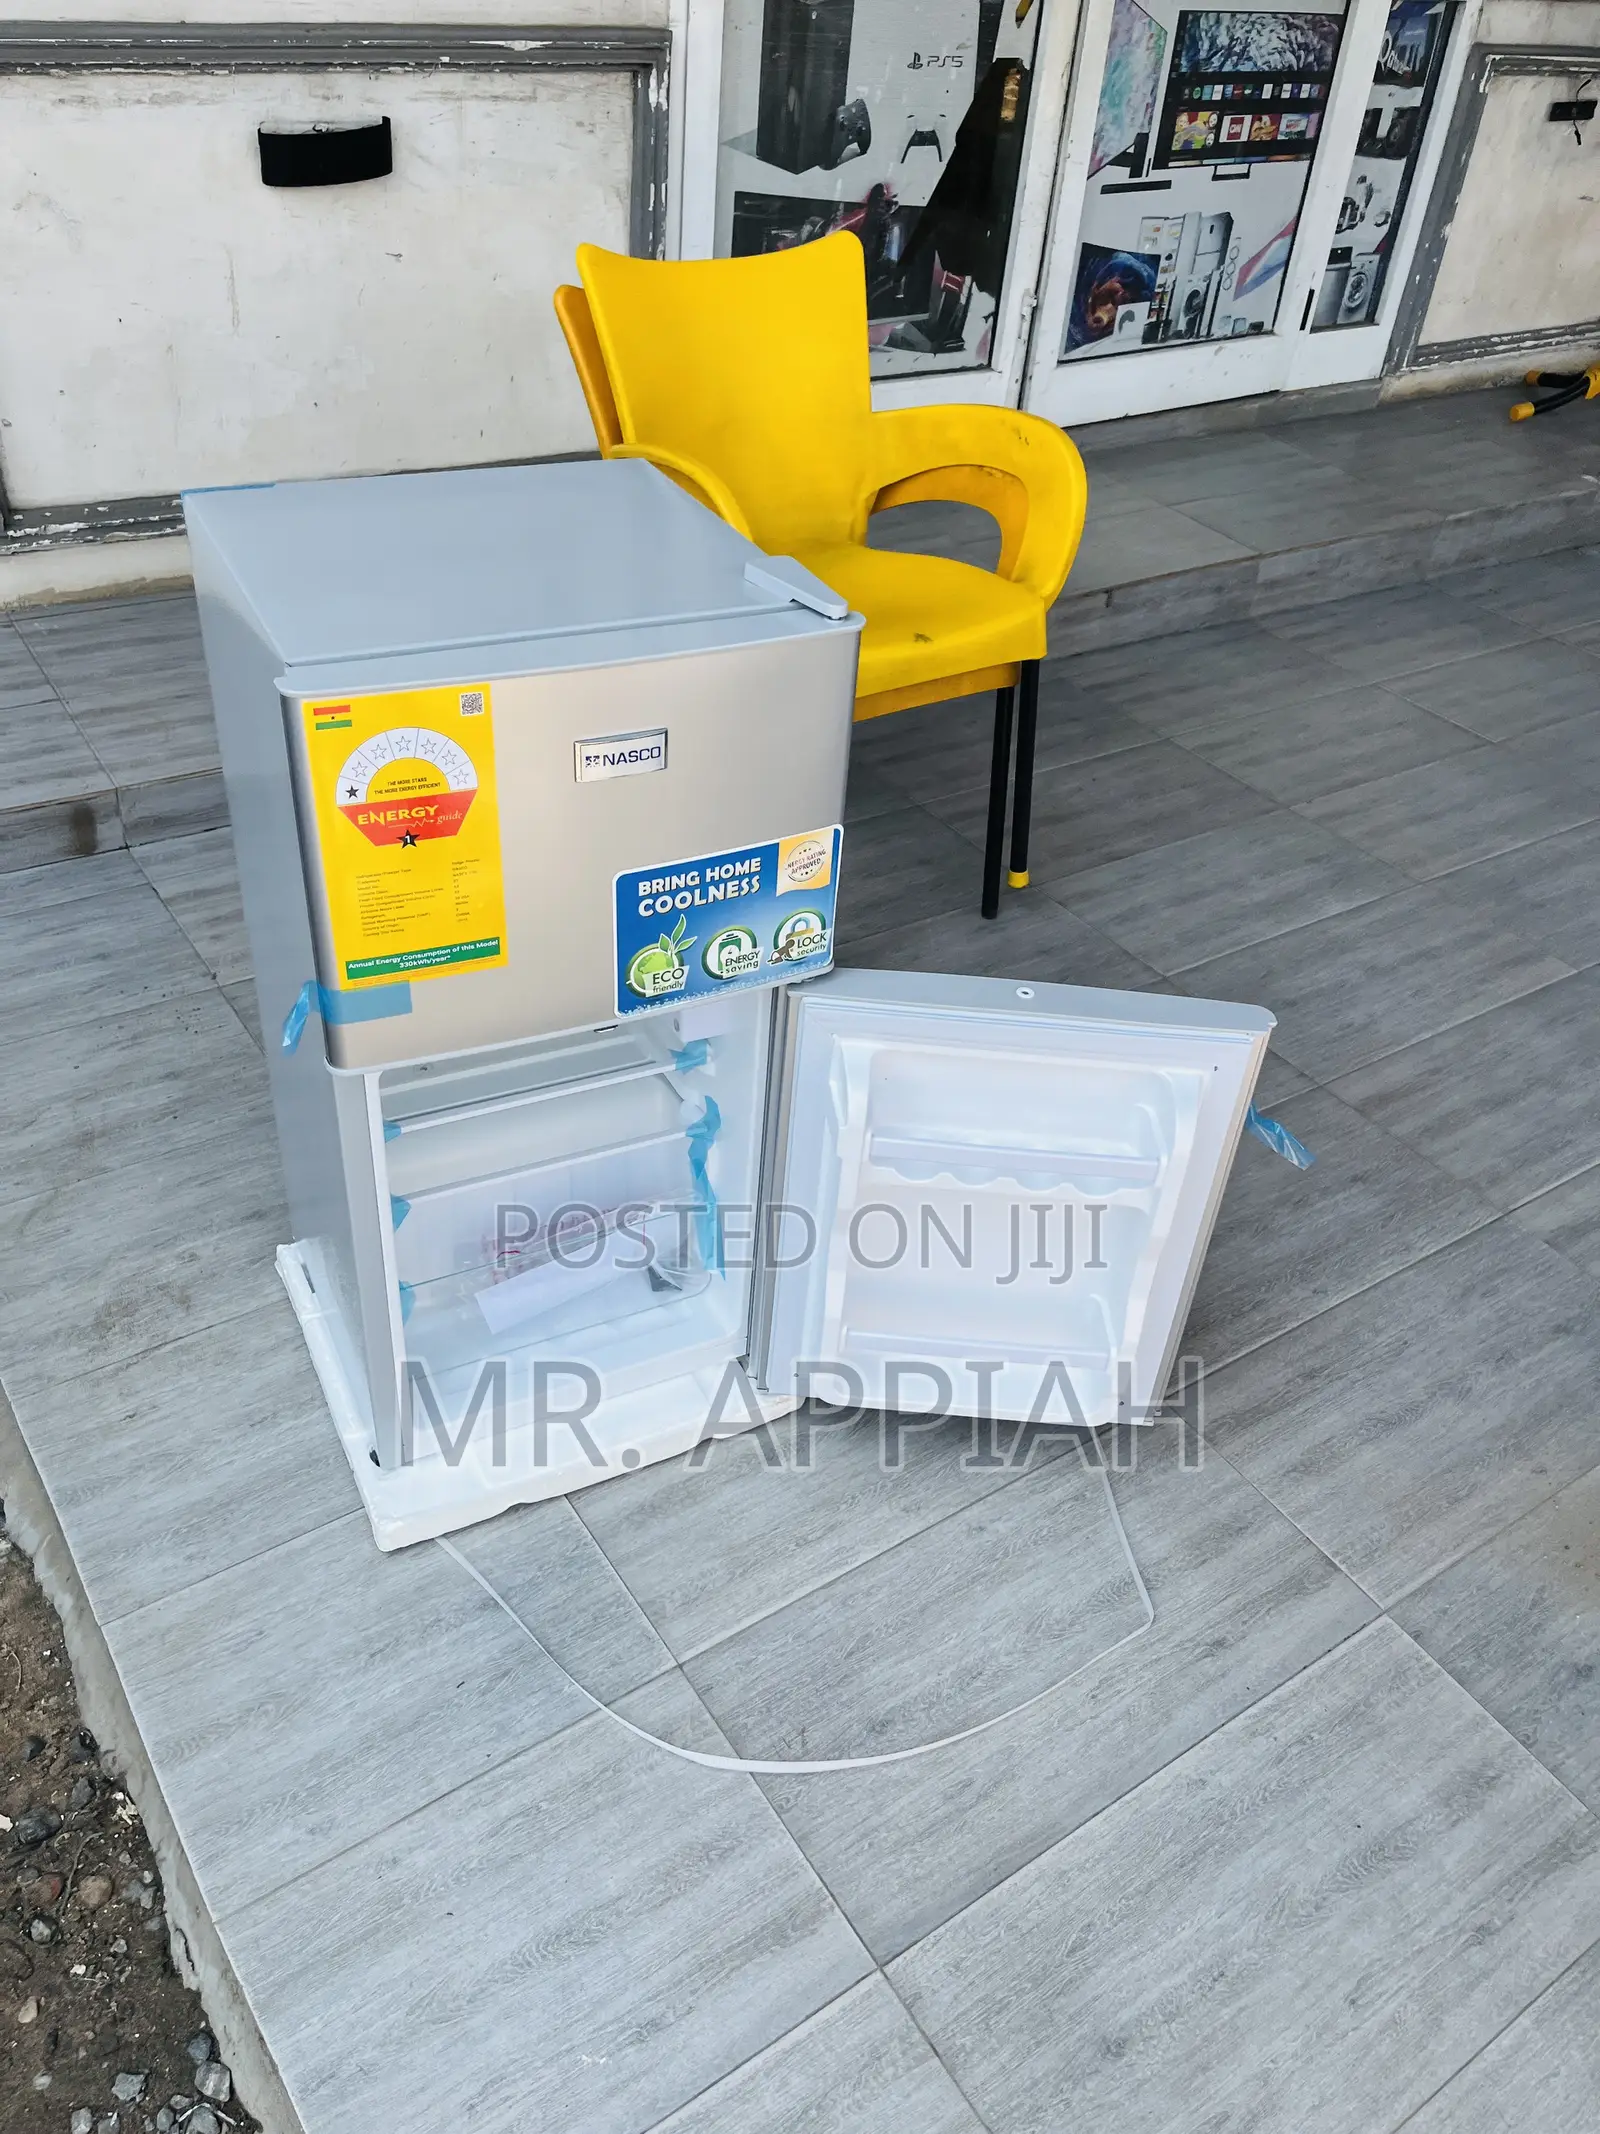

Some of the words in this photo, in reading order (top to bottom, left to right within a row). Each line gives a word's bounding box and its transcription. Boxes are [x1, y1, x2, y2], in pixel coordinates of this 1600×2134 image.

[926, 55, 964, 68] PS5
[602, 746, 661, 767] NASCO
[418, 782, 441, 790] EFFICIENT
[357, 804, 439, 826] ENERGY
[437, 810, 463, 825] guide
[405, 835, 412, 844] 1
[791, 857, 821, 874] APPROVED
[638, 871, 700, 897] BRING
[705, 857, 762, 883] HOME
[638, 875, 761, 918] COOLNESS
[798, 931, 827, 949] LOCK
[348, 960, 375, 970] Annual
[376, 956, 402, 965] Energy
[402, 948, 451, 961] Consumption
[461, 943, 475, 951] this
[476, 939, 499, 948] Model
[725, 950, 760, 967] ENERGY
[797, 943, 827, 957] security
[652, 967, 684, 985] ECO
[725, 961, 759, 974] saving
[652, 980, 685, 994] friendly
